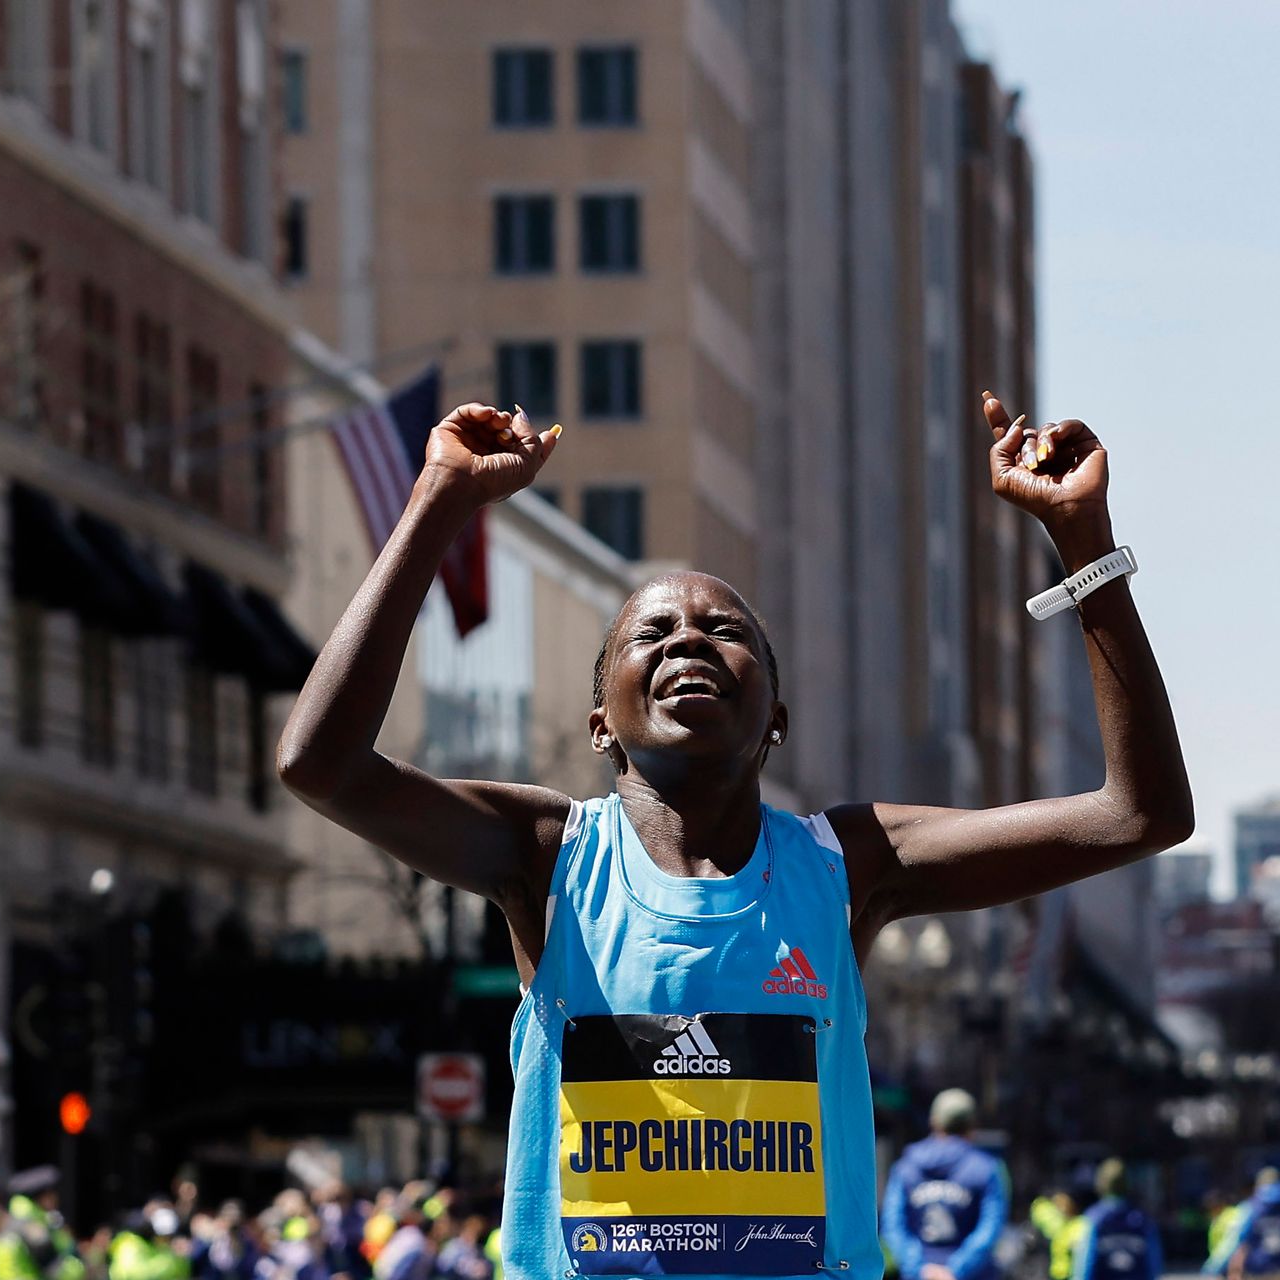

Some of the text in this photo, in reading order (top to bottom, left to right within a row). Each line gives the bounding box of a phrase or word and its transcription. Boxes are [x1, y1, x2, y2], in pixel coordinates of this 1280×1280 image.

[761, 976, 828, 1000] adidas
[653, 1054, 732, 1075] adidas
[570, 1118, 815, 1174] JEPCHIRCHIR
[610, 1223, 648, 1237] 126TH
[650, 1223, 718, 1237] BOSTON
[734, 1223, 817, 1252] John Hancock
[611, 1237, 719, 1253] MARATHON
